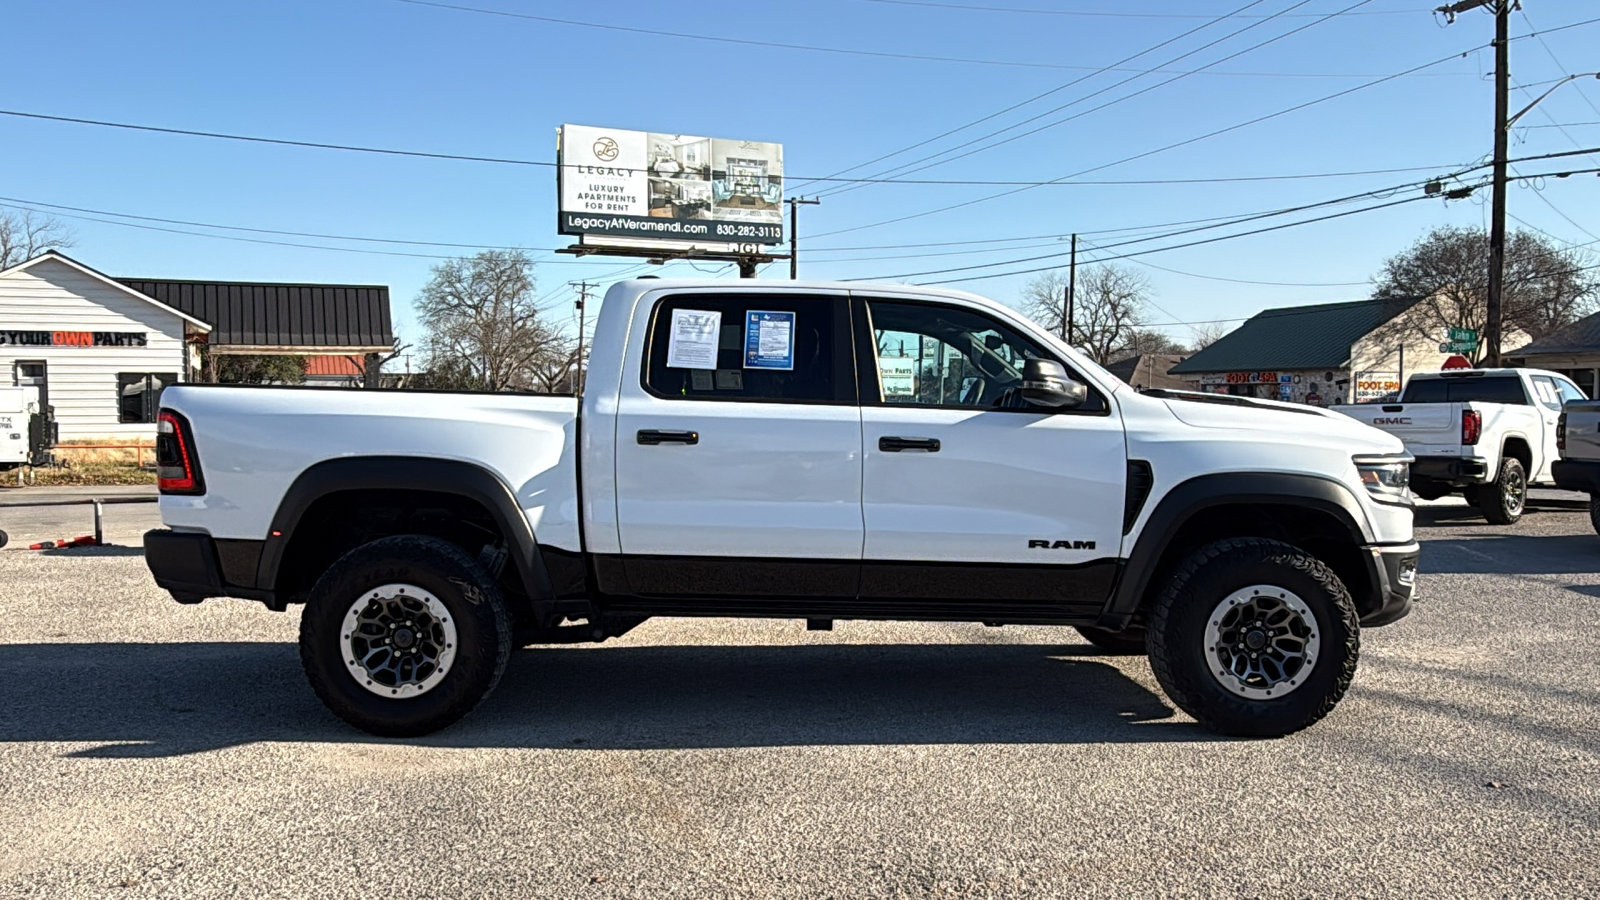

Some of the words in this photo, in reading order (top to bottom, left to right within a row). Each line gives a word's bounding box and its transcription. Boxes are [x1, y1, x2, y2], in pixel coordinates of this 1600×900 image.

[578, 165, 634, 177] LEGACY
[589, 184, 625, 193] LUXURY
[577, 192, 636, 203] APARTMENTS
[607, 203, 629, 211] RENT
[568, 215, 708, 234] LegacyAtVeramendi.com
[717, 223, 781, 238] 830-282-3113
[9, 331, 51, 345] YOUR
[52, 331, 93, 347] OWN
[94, 332, 147, 346] PARTS
[1226, 372, 1249, 383] FOOT
[1259, 372, 1277, 383] SPA
[1357, 381, 1382, 390] FOOT
[1384, 381, 1400, 390] SPA
[1373, 417, 1412, 425] GMC
[1028, 539, 1096, 550] RAM
